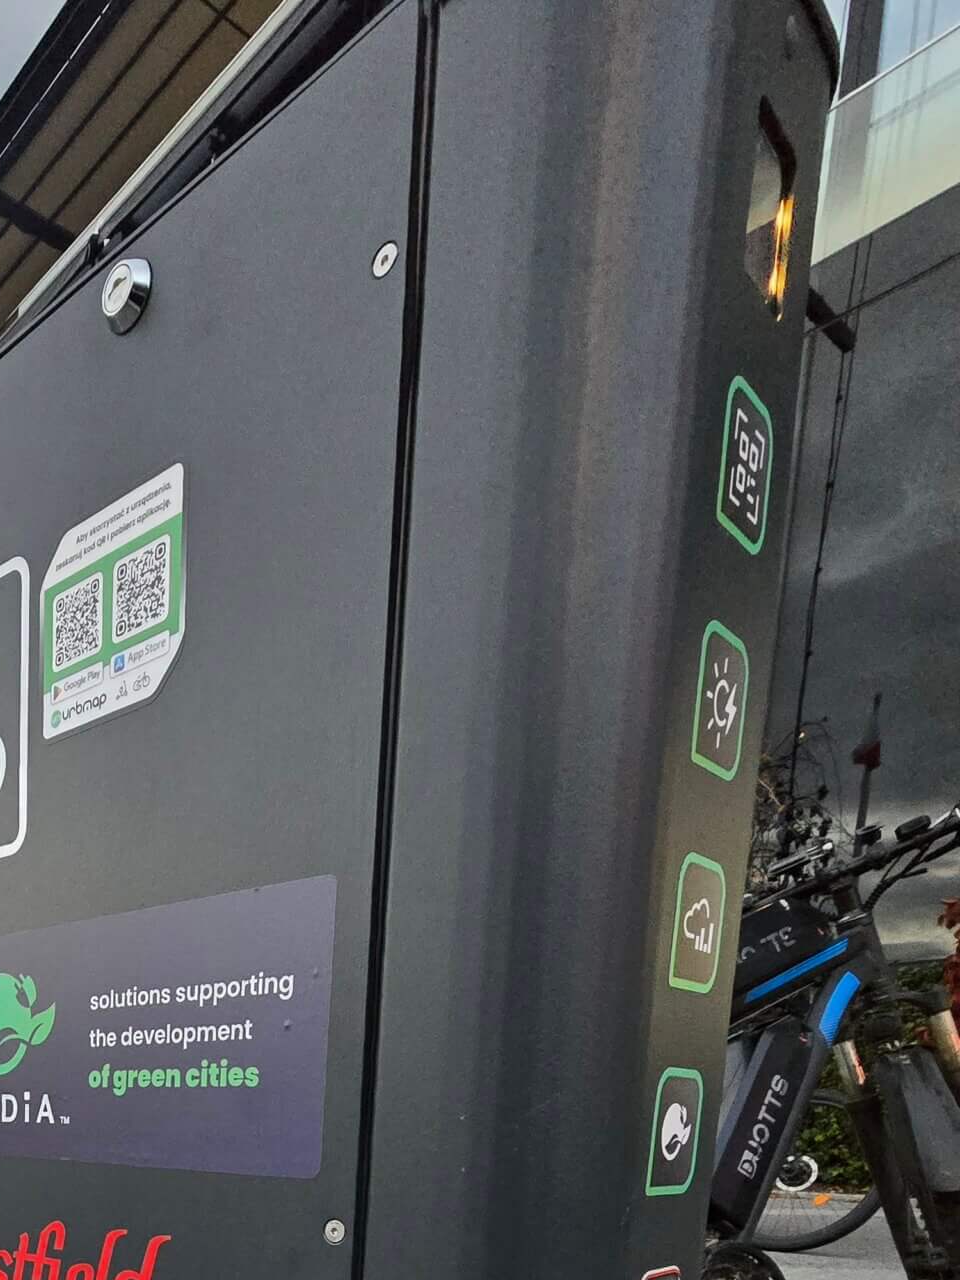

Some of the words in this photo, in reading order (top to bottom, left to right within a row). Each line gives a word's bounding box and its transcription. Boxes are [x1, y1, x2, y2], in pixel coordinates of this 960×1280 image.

[83, 541, 95, 555] kod
[96, 535, 106, 547] QR
[128, 649, 144, 663] App
[144, 639, 166, 655] Store
[63, 675, 87, 692] Google
[87, 670, 101, 682] Play
[62, 693, 107, 720] urbmap
[90, 986, 171, 1011] solutions
[175, 971, 295, 1007] supporting
[89, 1028, 117, 1048] the
[121, 1019, 253, 1050] development
[88, 1063, 111, 1089] of
[112, 1068, 181, 1096] green
[185, 1058, 260, 1088] cities
